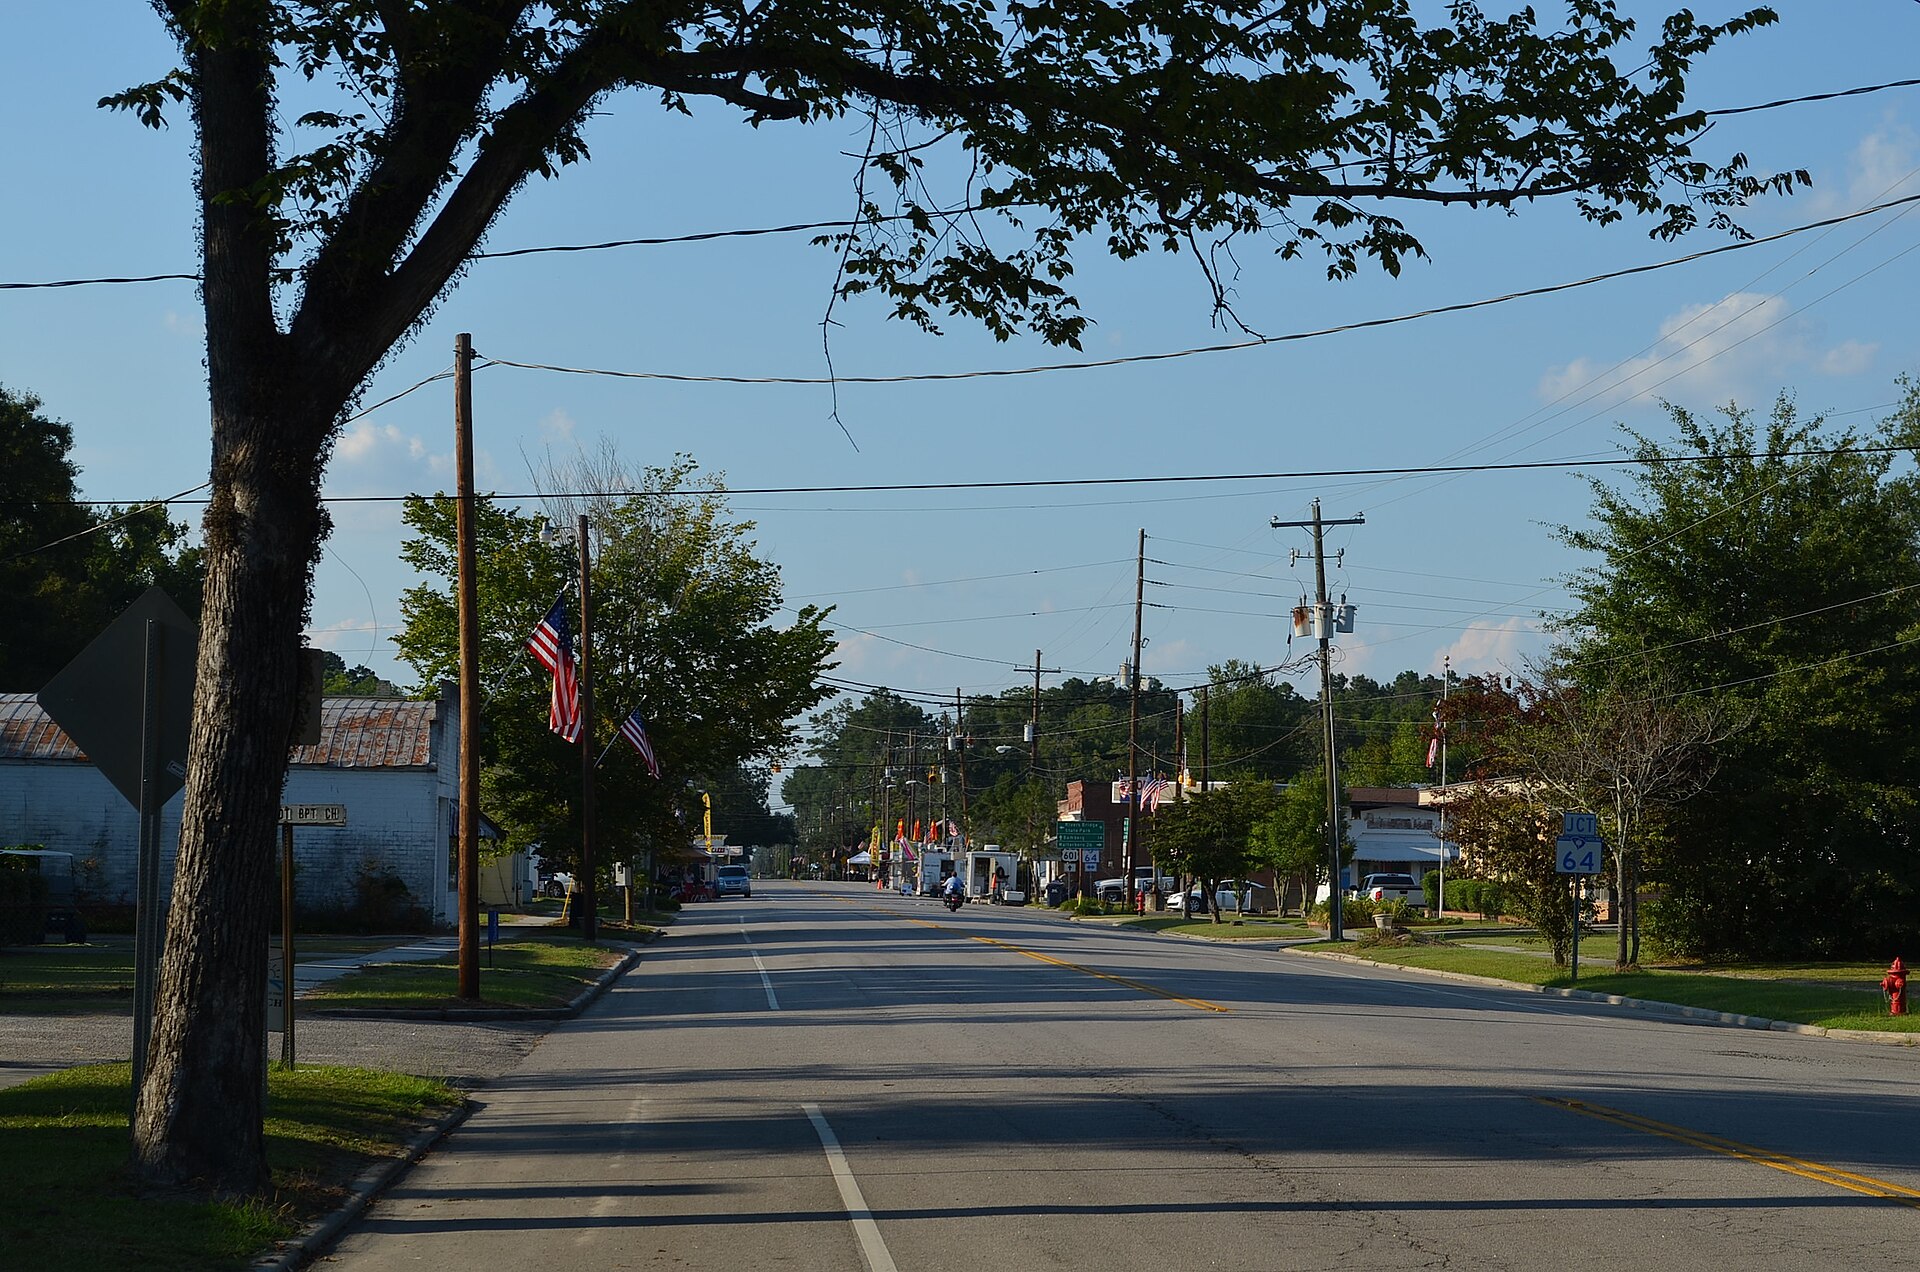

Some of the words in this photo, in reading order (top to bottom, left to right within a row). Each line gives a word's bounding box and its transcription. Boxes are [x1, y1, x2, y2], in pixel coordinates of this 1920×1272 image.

[299, 808, 316, 819] BPT
[325, 808, 338, 819] CH
[1566, 817, 1593, 832] JCT
[1063, 852, 1077, 860] 601
[1563, 851, 1594, 871] 64
